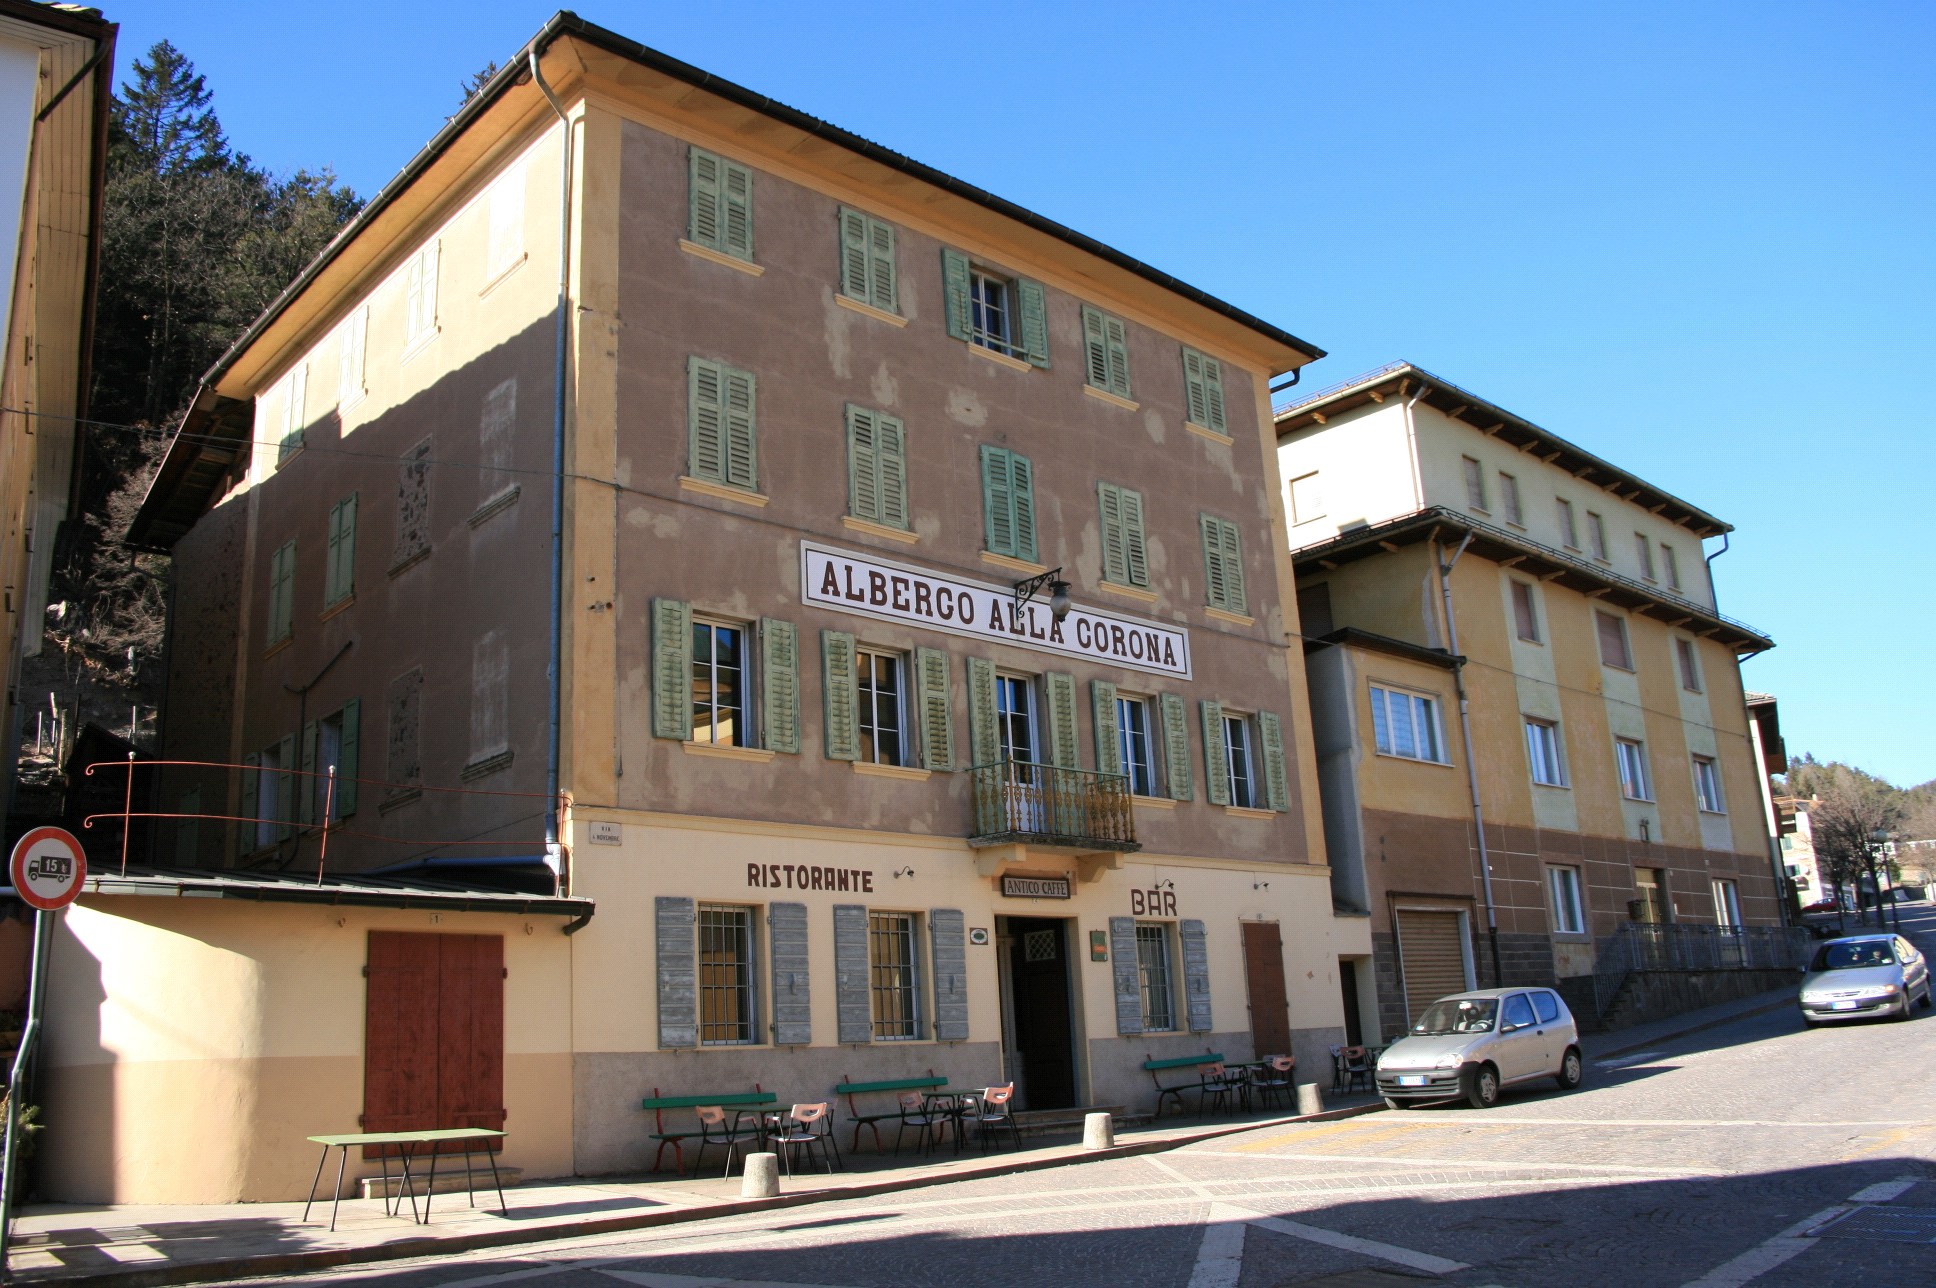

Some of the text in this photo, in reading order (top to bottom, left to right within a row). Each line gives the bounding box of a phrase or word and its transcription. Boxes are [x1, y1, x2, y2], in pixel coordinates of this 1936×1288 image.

[821, 561, 1177, 666] ALBERGO ALLA CORONA
[45, 859, 58, 872] 15
[747, 863, 873, 893] RISTORANTE
[1007, 880, 1040, 894] ANTICO
[1131, 889, 1177, 916] BAR
